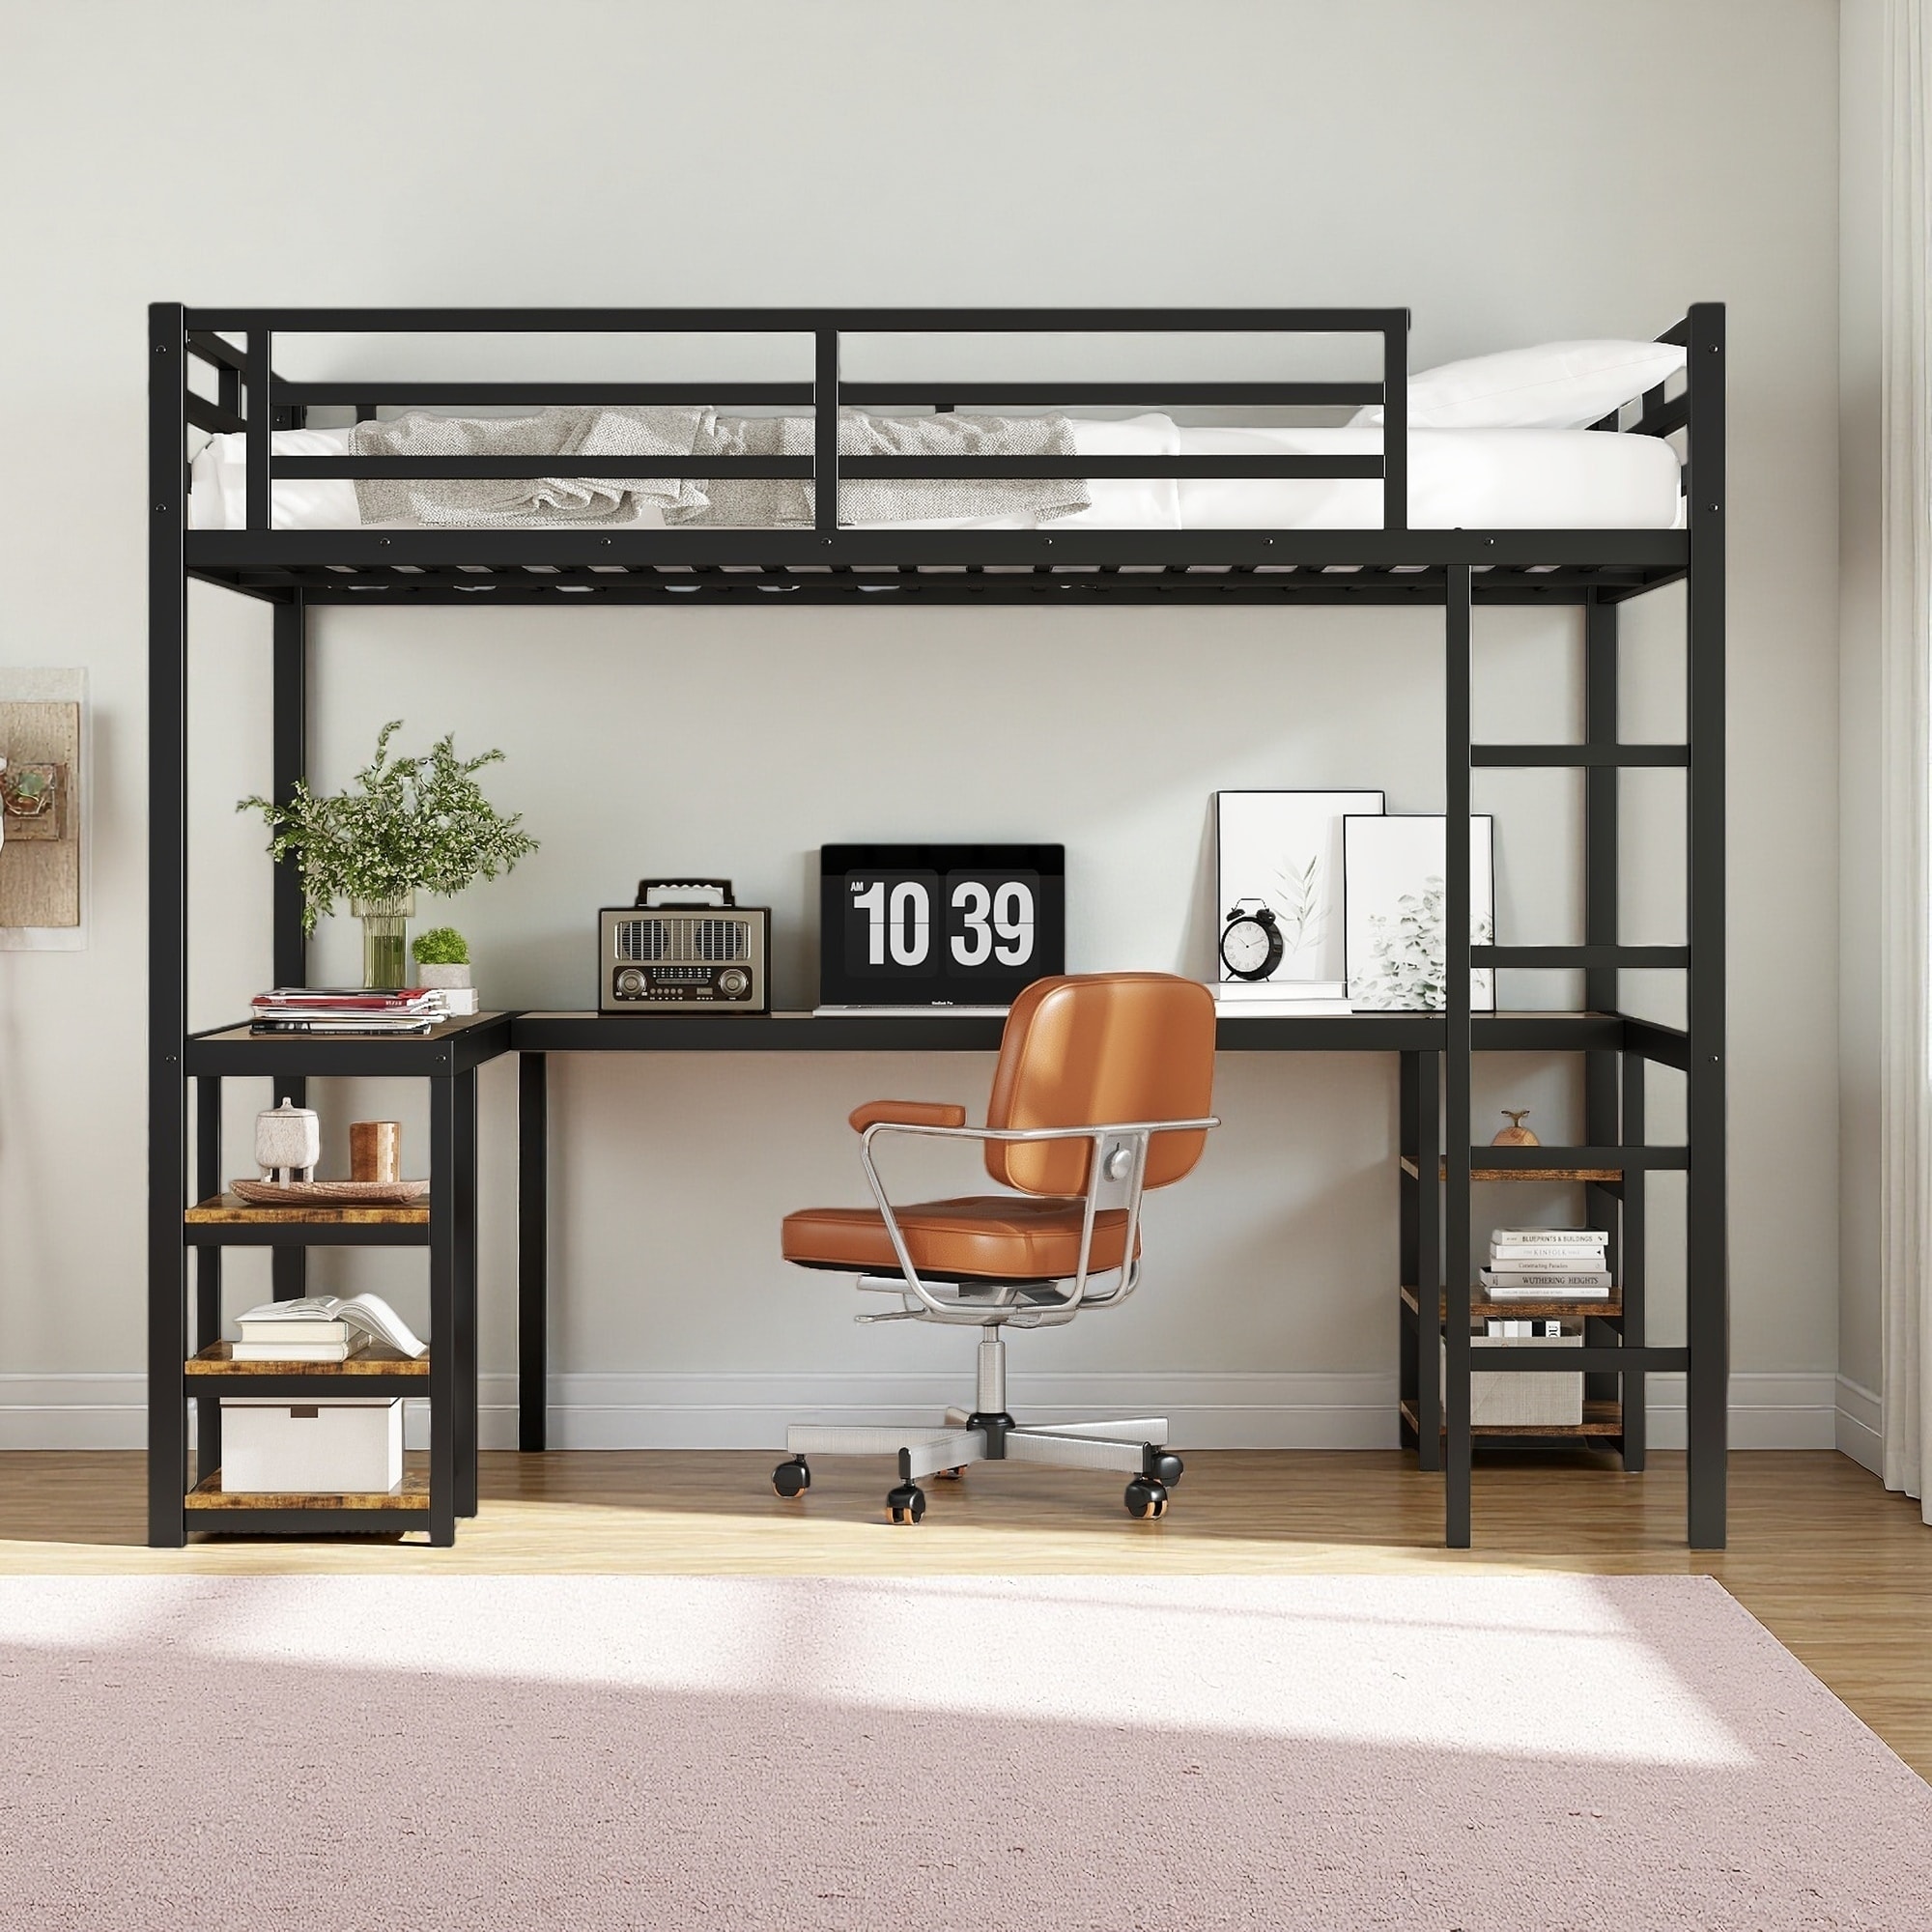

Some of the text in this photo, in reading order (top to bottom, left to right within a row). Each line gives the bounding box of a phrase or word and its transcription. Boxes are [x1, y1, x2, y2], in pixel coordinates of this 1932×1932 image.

[850, 881, 864, 892] AM
[853, 881, 1035, 966] 10 39
[1521, 1276, 1566, 1285] WUTHERING
